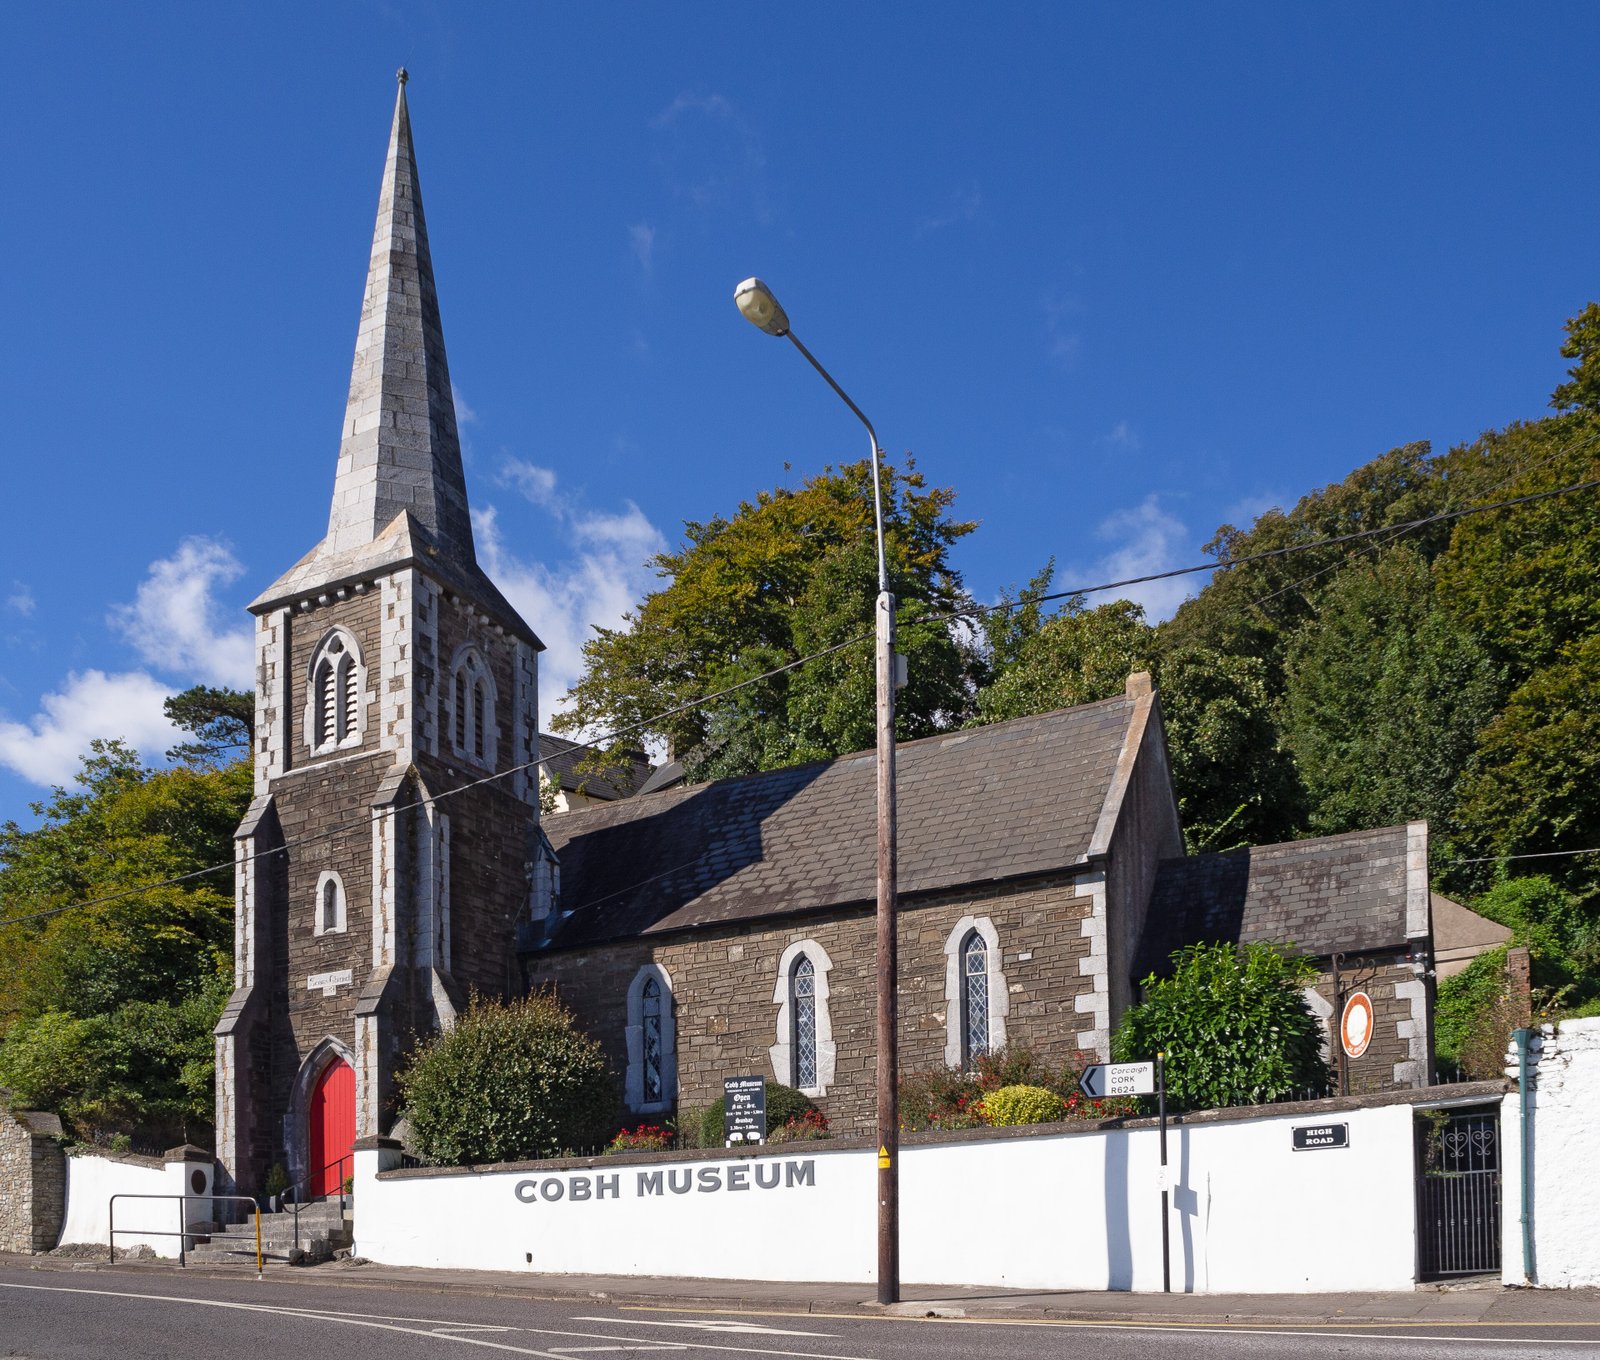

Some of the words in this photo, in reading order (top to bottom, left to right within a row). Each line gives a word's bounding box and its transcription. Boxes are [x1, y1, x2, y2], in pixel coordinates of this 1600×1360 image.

[1111, 1066, 1148, 1075] Corcaigh
[1111, 1076, 1135, 1084] CORK
[725, 1081, 739, 1089] Cobh
[1111, 1086, 1135, 1094] R624
[734, 1094, 750, 1102] Open
[514, 1173, 620, 1203] COBH
[636, 1159, 816, 1198] MUSEUM
